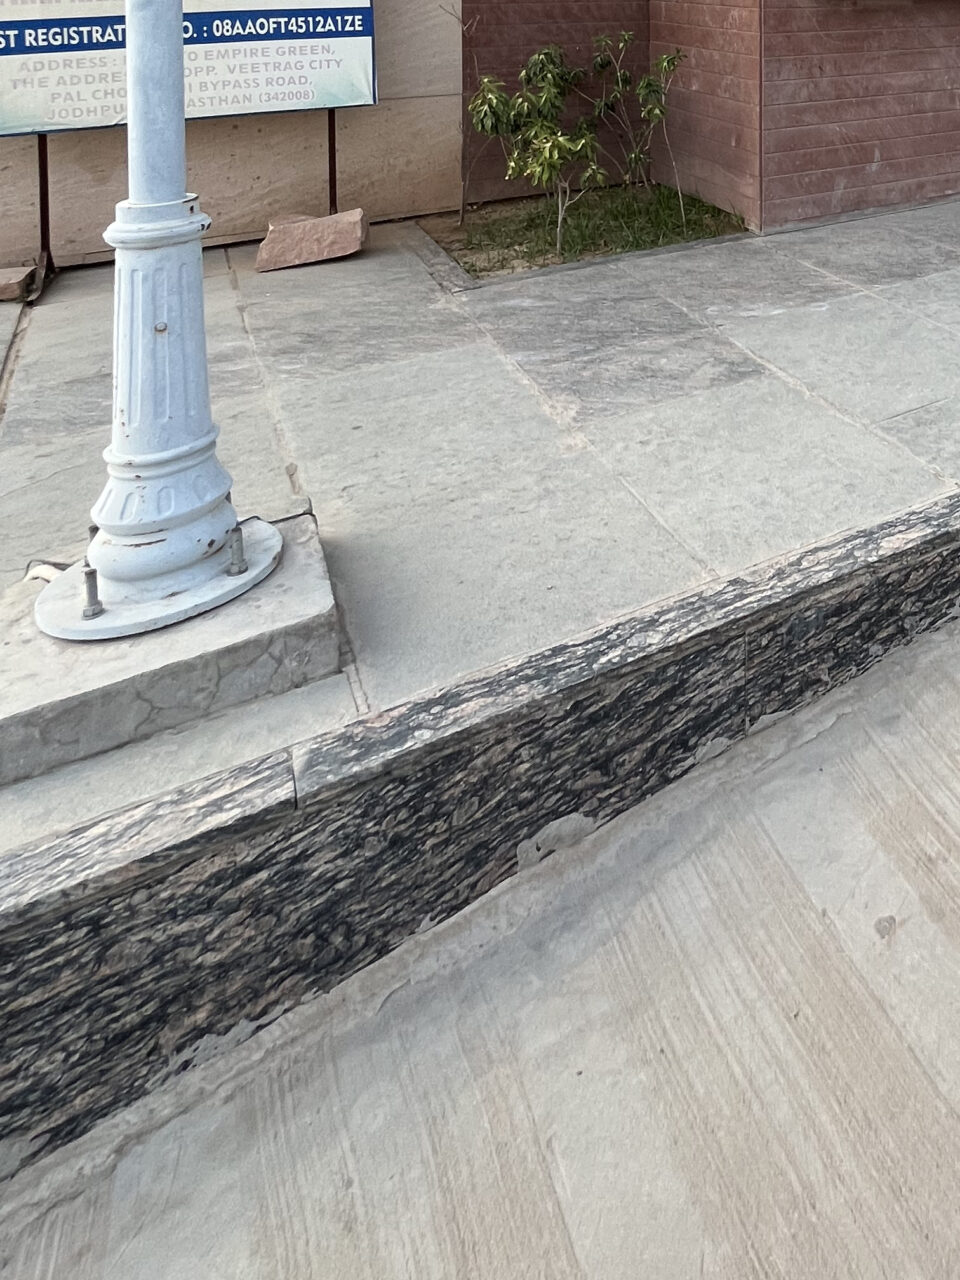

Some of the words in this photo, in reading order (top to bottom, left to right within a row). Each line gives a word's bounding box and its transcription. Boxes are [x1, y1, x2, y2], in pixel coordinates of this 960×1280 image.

[24, 24, 126, 47] REGISTRAT
[183, 21, 198, 39] O.
[18, 56, 108, 73] ADDRESS
[187, 50, 199, 62] O
[204, 47, 271, 61] EMPIRE
[275, 44, 336, 58] GREEN,
[10, 76, 49, 90] THE
[56, 71, 127, 87] ADDRE
[227, 60, 305, 75] VEETRAG
[309, 58, 343, 70] CITY
[50, 90, 88, 104] PAL
[91, 87, 127, 100] CHO
[199, 78, 260, 93] BYPASS
[265, 75, 313, 88] ROAD,
[47, 103, 127, 120] JODHPU
[186, 94, 253, 109] ASTHAN
[258, 89, 316, 104] (342008)
